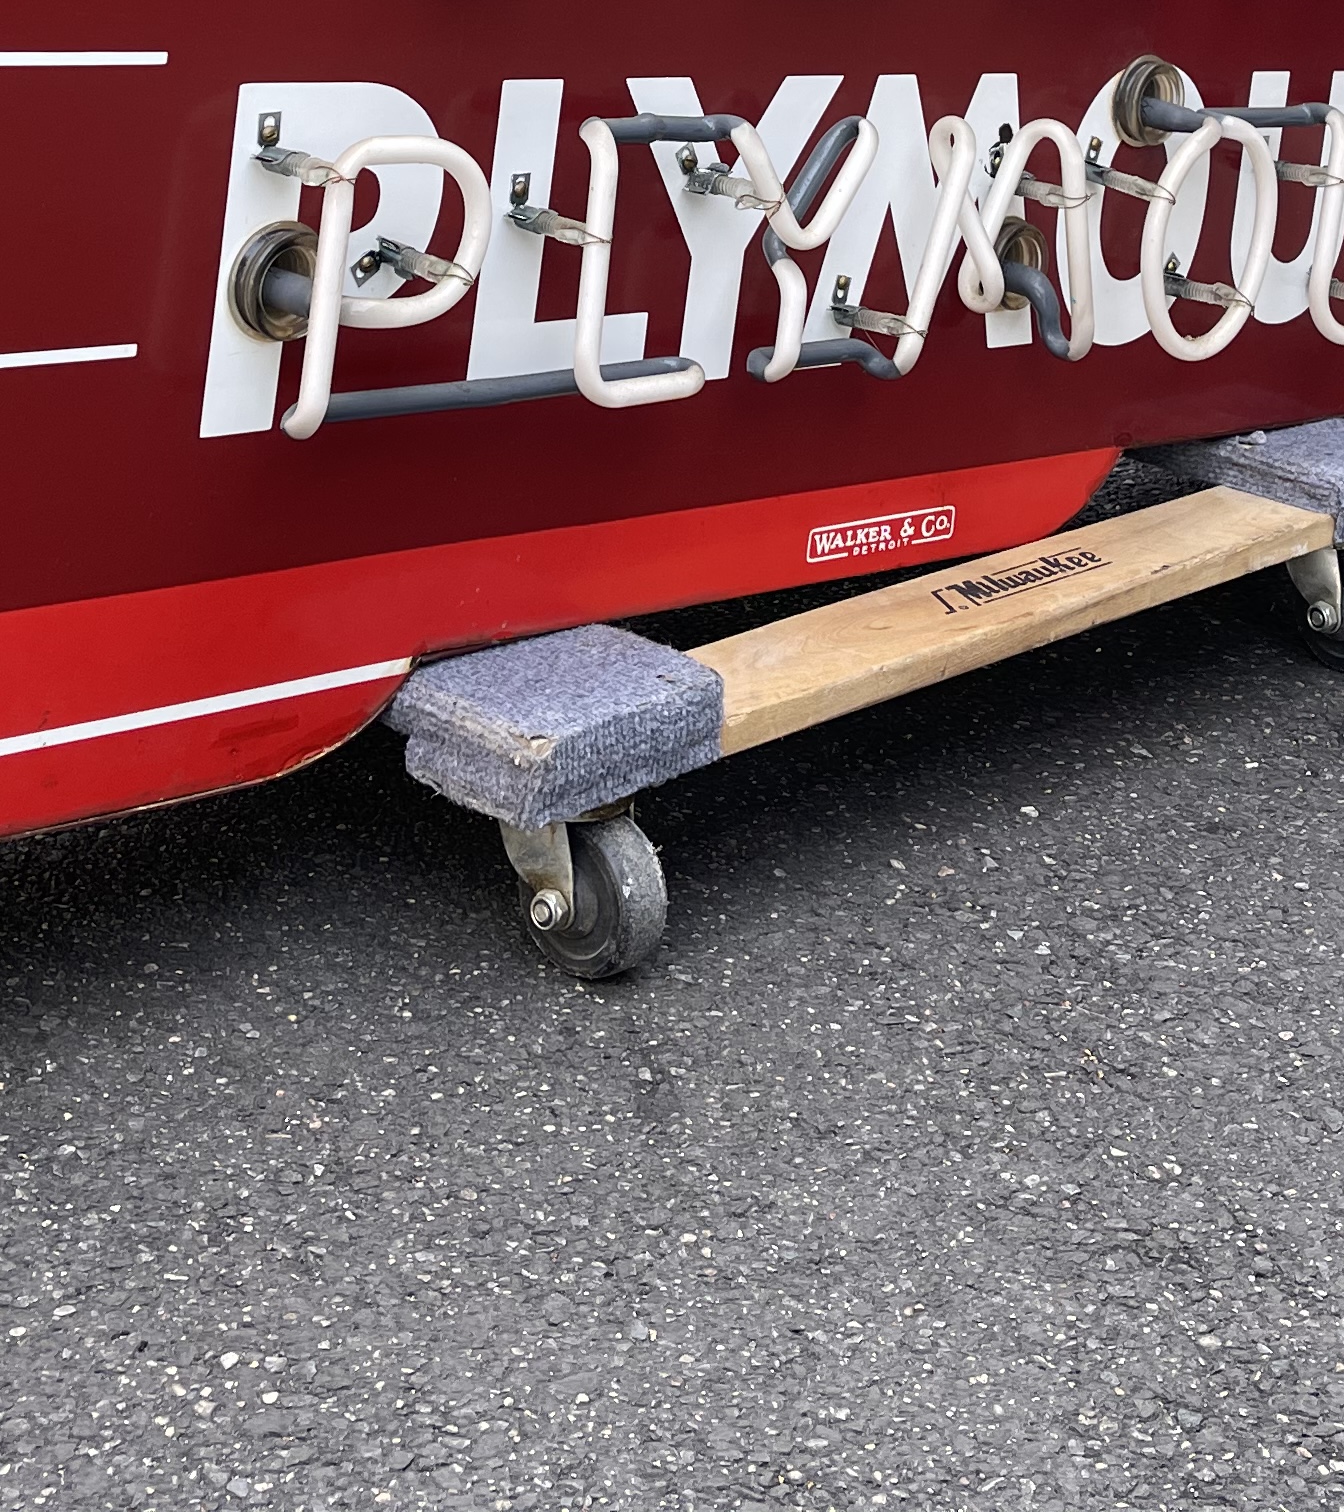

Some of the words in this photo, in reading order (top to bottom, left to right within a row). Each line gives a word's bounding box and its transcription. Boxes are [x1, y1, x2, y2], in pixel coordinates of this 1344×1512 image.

[813, 524, 892, 556] WALKER
[899, 517, 915, 538] &
[852, 537, 910, 557] DETROIT
[944, 550, 1102, 607] Milwaukee
